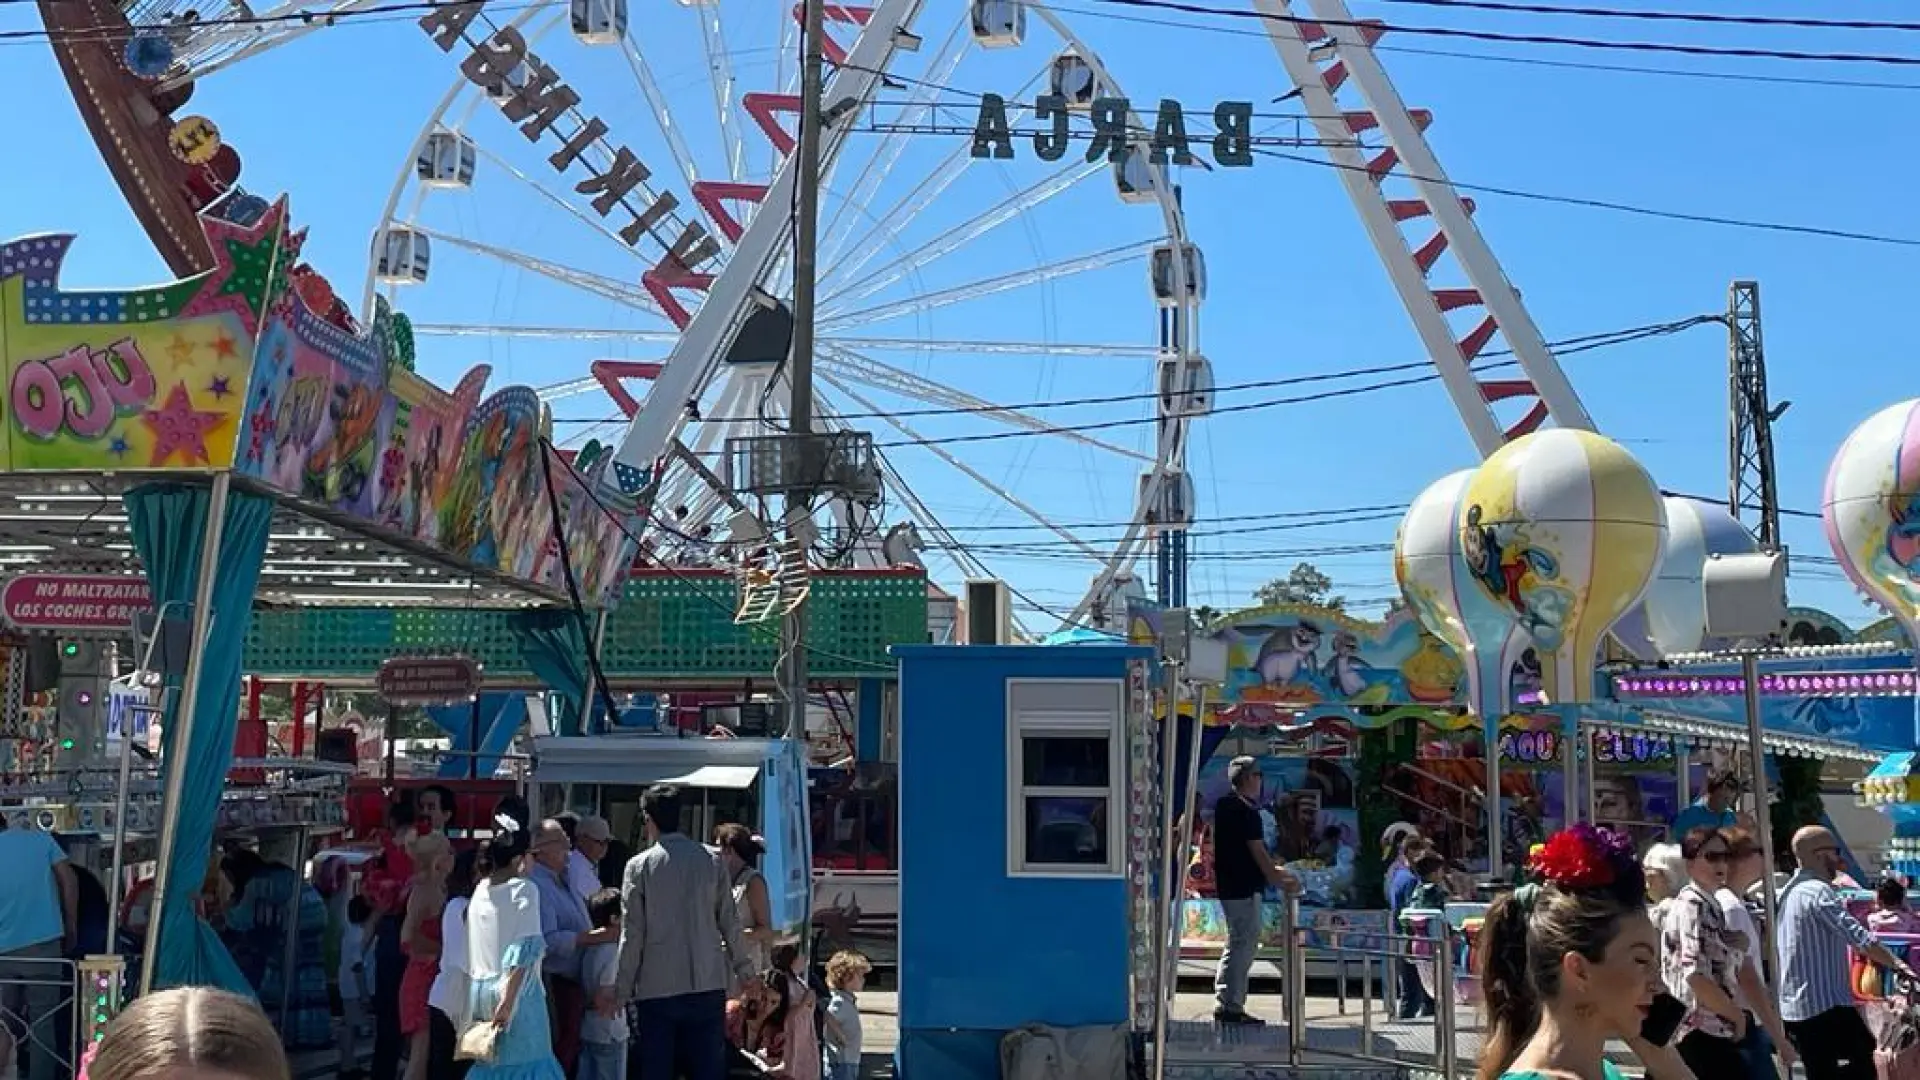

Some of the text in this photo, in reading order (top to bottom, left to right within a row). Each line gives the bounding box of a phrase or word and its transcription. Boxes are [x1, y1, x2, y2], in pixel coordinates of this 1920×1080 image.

[11, 335, 157, 439] OJU
[36, 583, 150, 599] NO MALTRATAR
[13, 603, 39, 617] LOS
